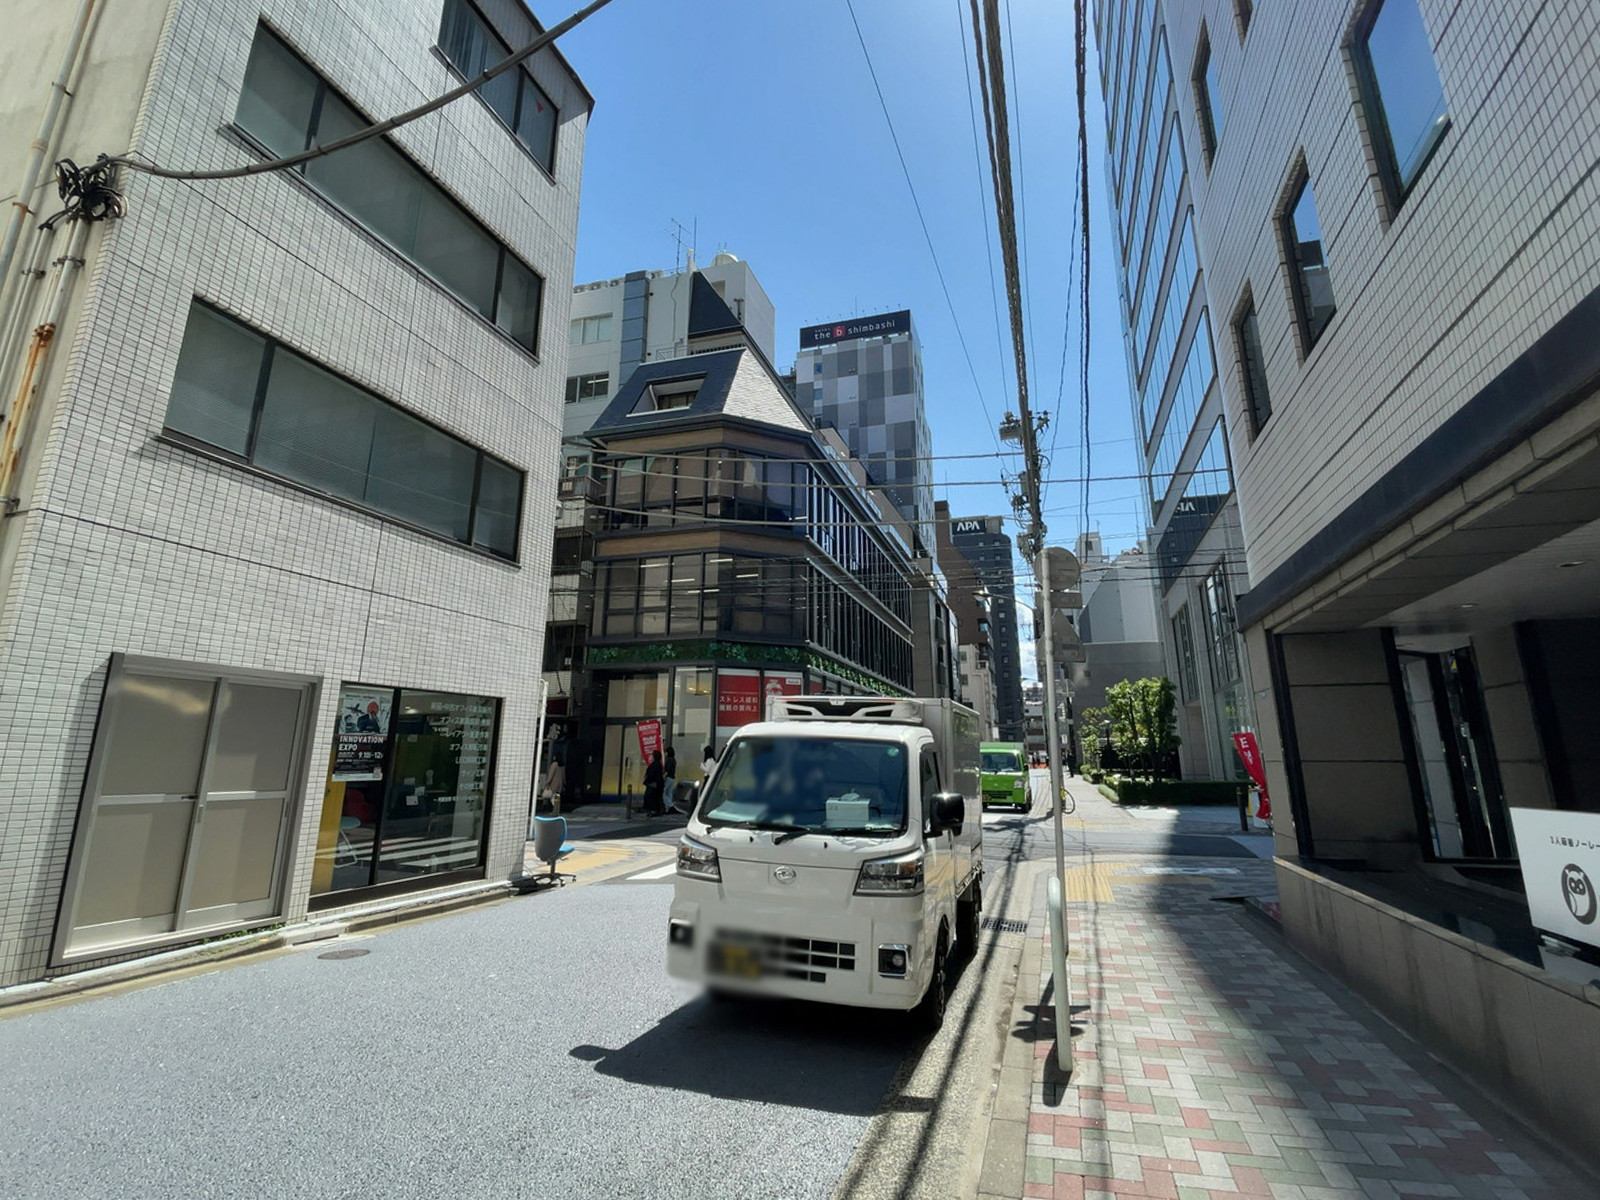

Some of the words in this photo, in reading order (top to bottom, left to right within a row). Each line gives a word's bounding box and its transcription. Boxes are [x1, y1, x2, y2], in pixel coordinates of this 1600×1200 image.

[814, 332, 831, 340] the
[847, 320, 896, 334] shimbashi
[956, 520, 980, 532] APA
[339, 735, 384, 744] INNOVATION
[338, 743, 358, 751] EXPO
